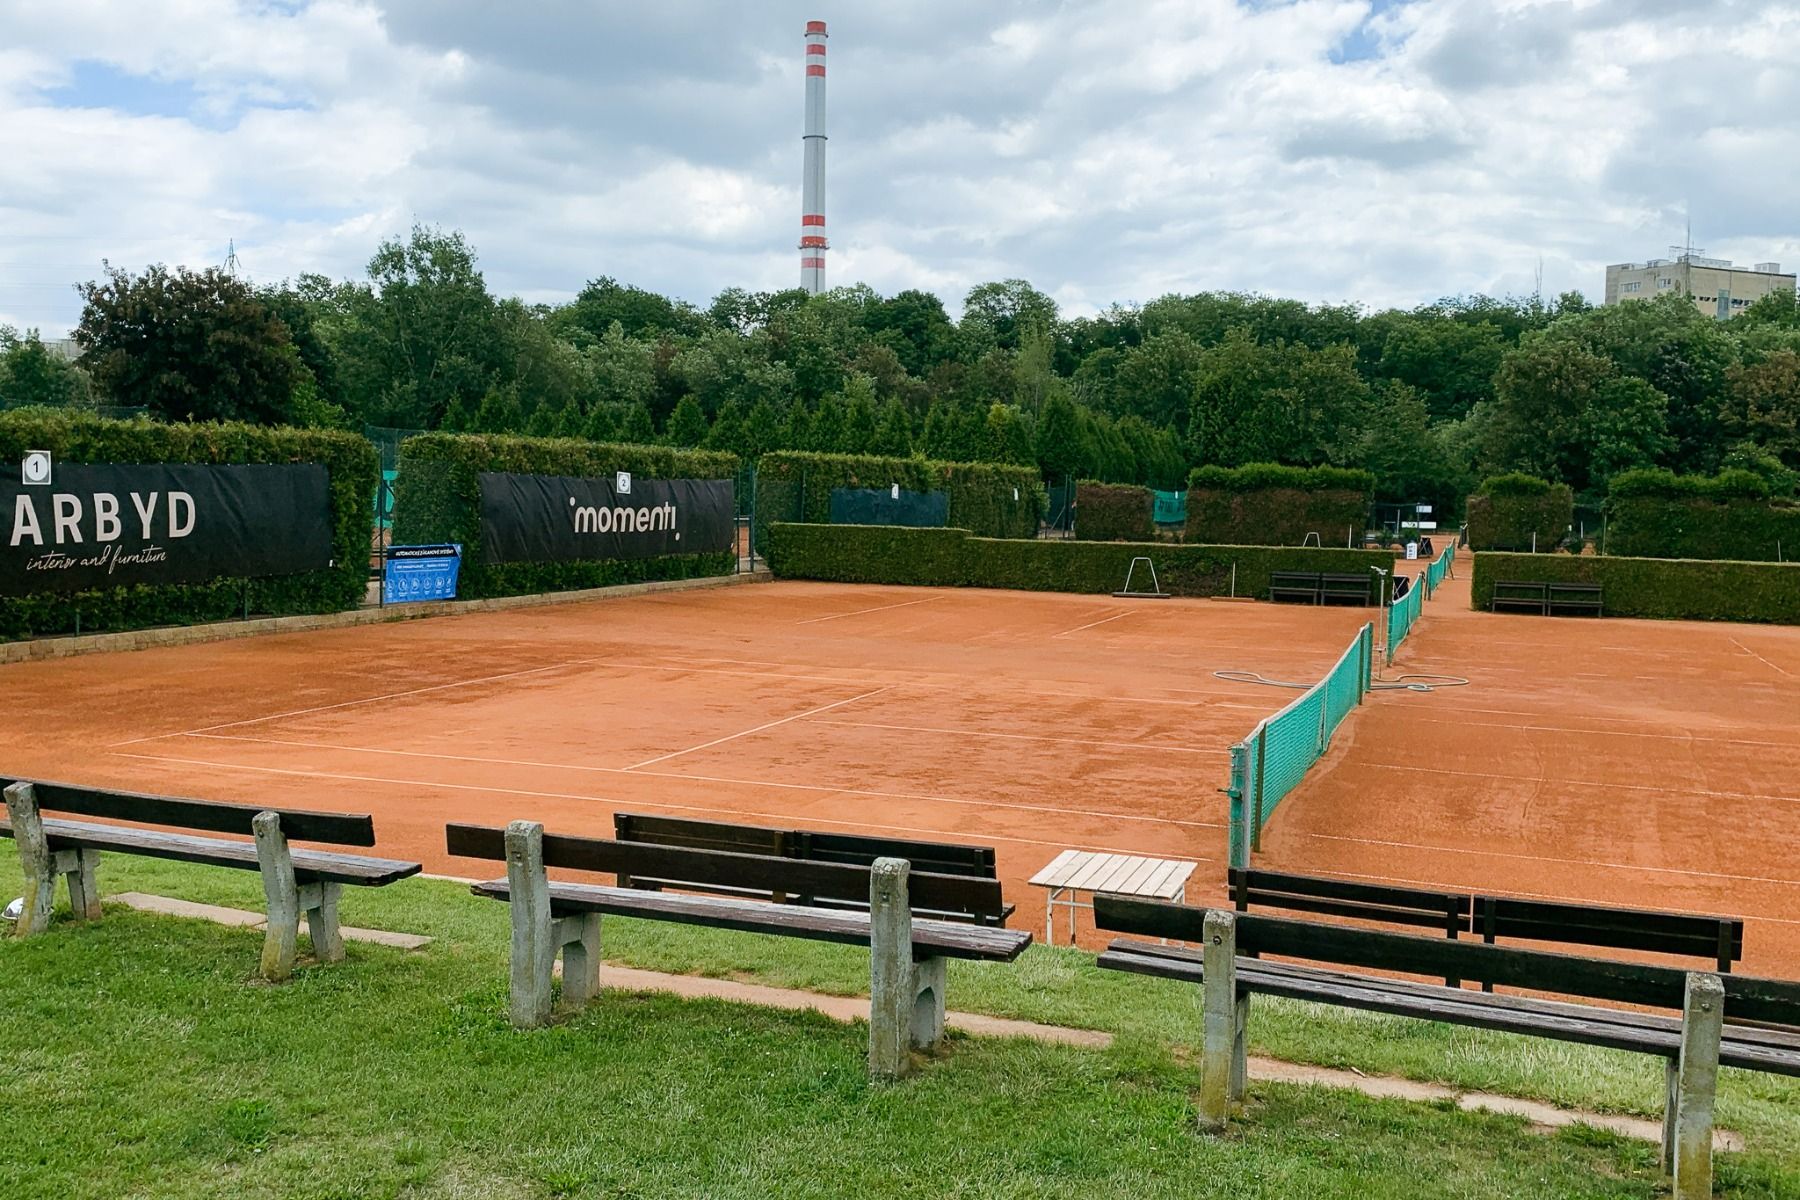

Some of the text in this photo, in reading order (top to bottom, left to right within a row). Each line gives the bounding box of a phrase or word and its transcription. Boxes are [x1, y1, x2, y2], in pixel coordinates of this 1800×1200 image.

[33, 461, 39, 473] 1
[10, 491, 196, 546] ARBYD
[26, 544, 167, 574] interior and furniture
